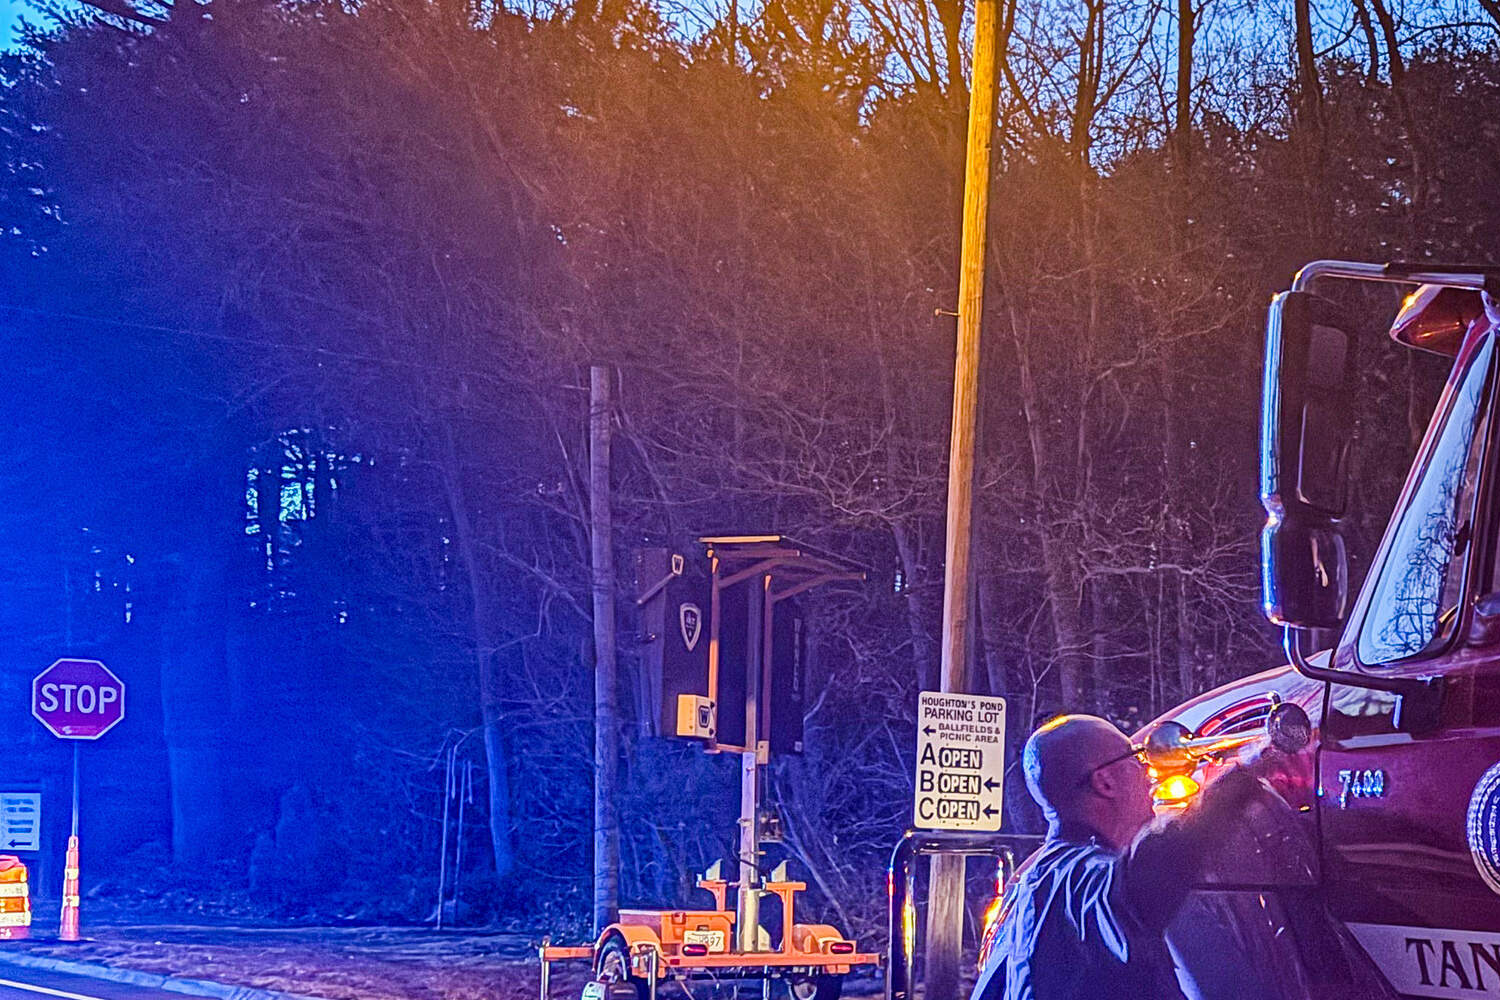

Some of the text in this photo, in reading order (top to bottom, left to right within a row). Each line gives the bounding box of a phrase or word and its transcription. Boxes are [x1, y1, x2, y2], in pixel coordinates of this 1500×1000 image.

[40, 682, 117, 714] STOP
[922, 697, 1003, 711] HOUGHTON'S POND
[924, 707, 999, 723] PARKING LOT
[938, 723, 993, 734] BALLFIELDS
[940, 732, 998, 743] PICNIC AREA
[920, 742, 981, 768] A OPEN
[920, 770, 979, 794] B OPEN
[919, 797, 978, 820] C OPEN
